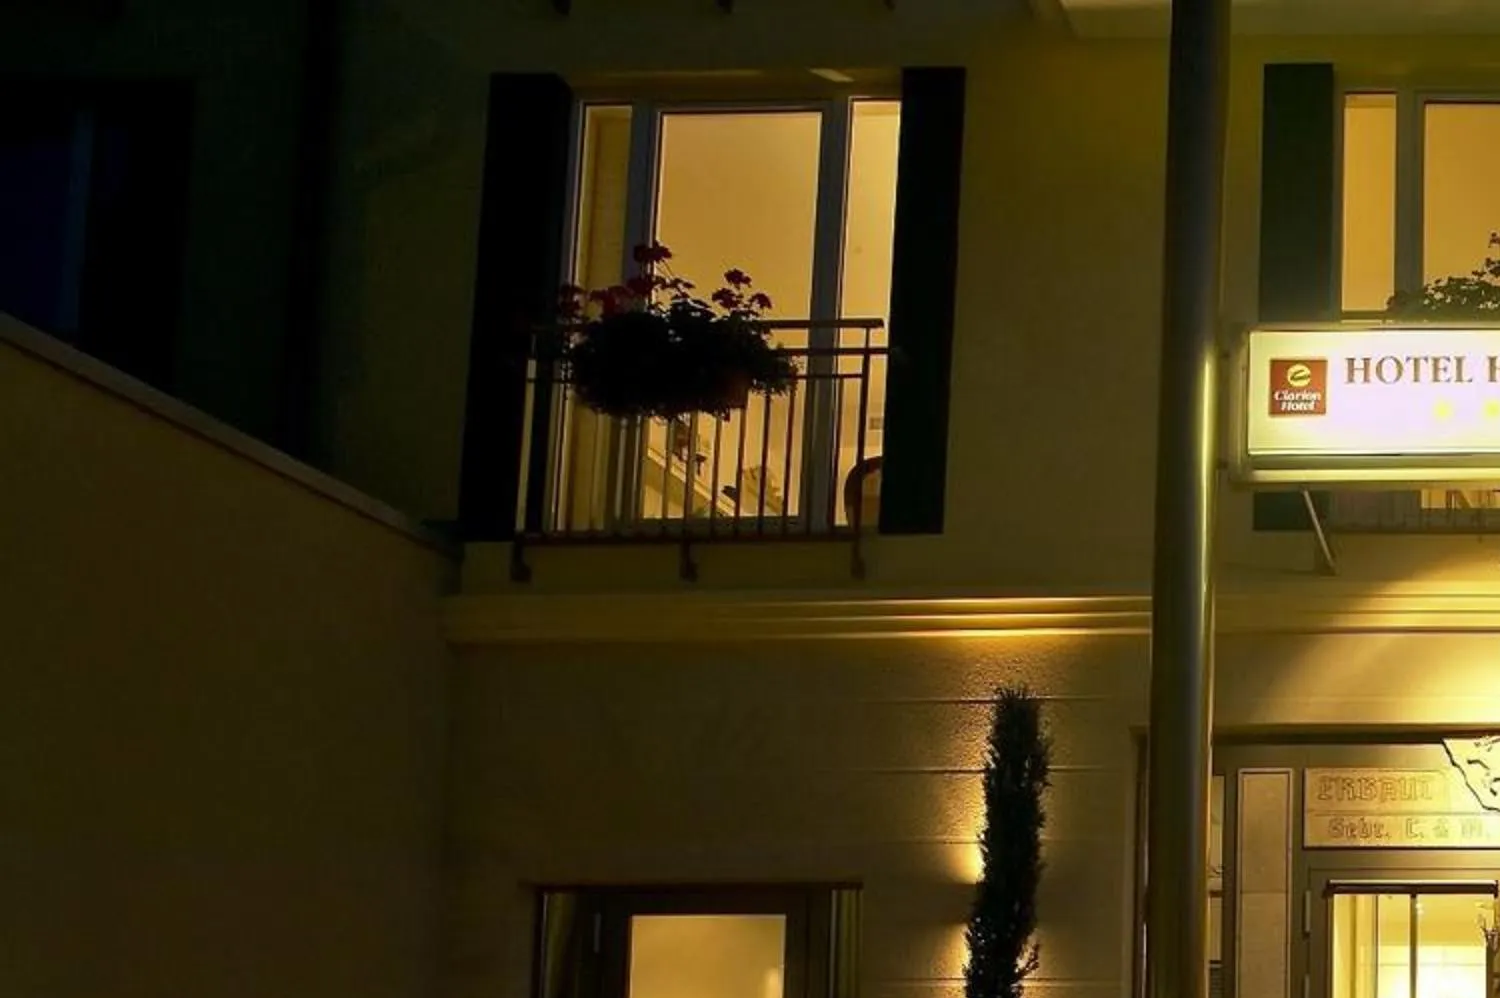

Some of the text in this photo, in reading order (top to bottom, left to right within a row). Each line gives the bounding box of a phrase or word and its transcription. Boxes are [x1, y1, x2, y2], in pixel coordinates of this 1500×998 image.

[1344, 355, 1473, 384] HOTEL
[1273, 389, 1321, 401] Clarion
[1281, 400, 1315, 412] Hotel
